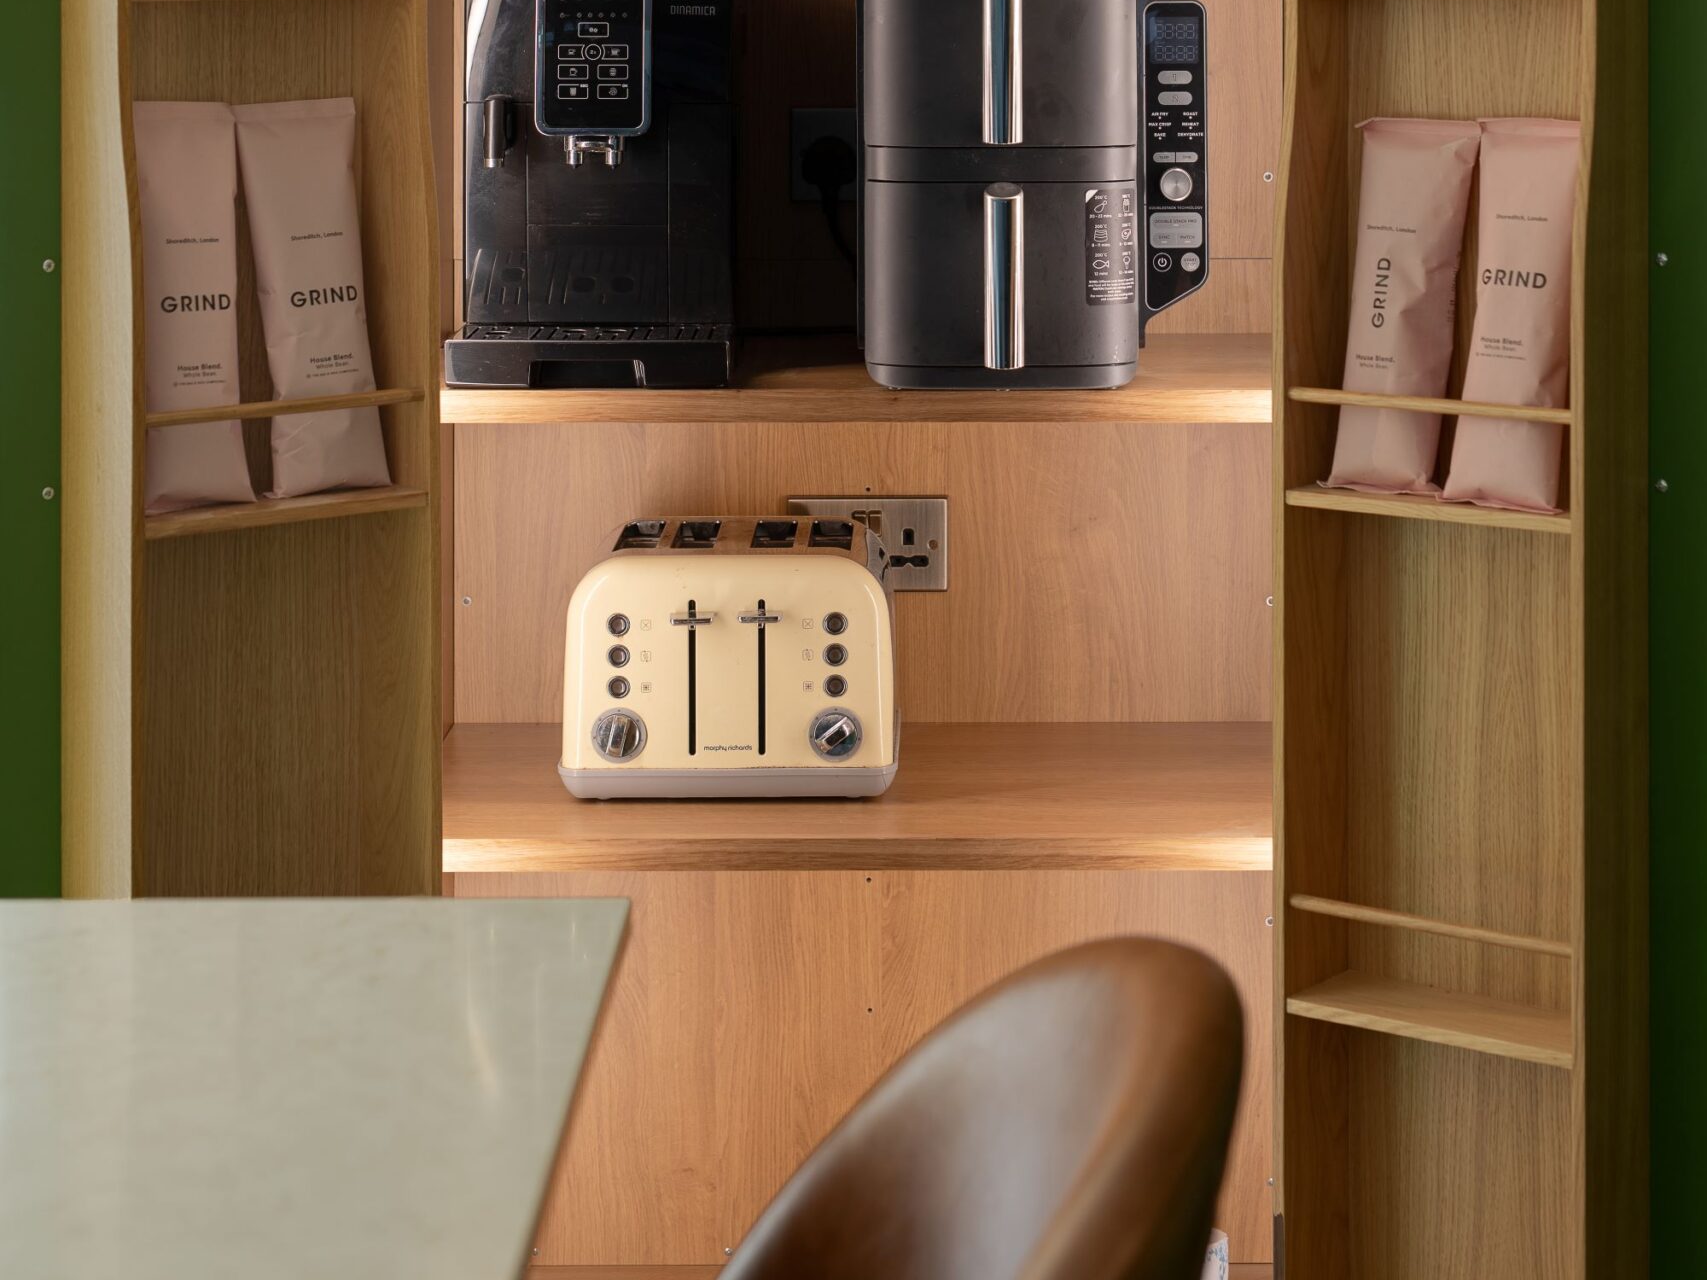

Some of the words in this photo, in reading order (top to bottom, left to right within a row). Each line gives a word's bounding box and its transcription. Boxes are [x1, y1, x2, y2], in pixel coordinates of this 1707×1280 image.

[670, 4, 717, 17] DINAMICA
[1481, 268, 1548, 290] GRIND
[290, 285, 358, 308] GRIND
[1371, 257, 1392, 329] GRIND
[160, 293, 231, 314] GRIND
[1480, 336, 1501, 344] House
[309, 356, 332, 364] House
[703, 744, 728, 753] morphy
